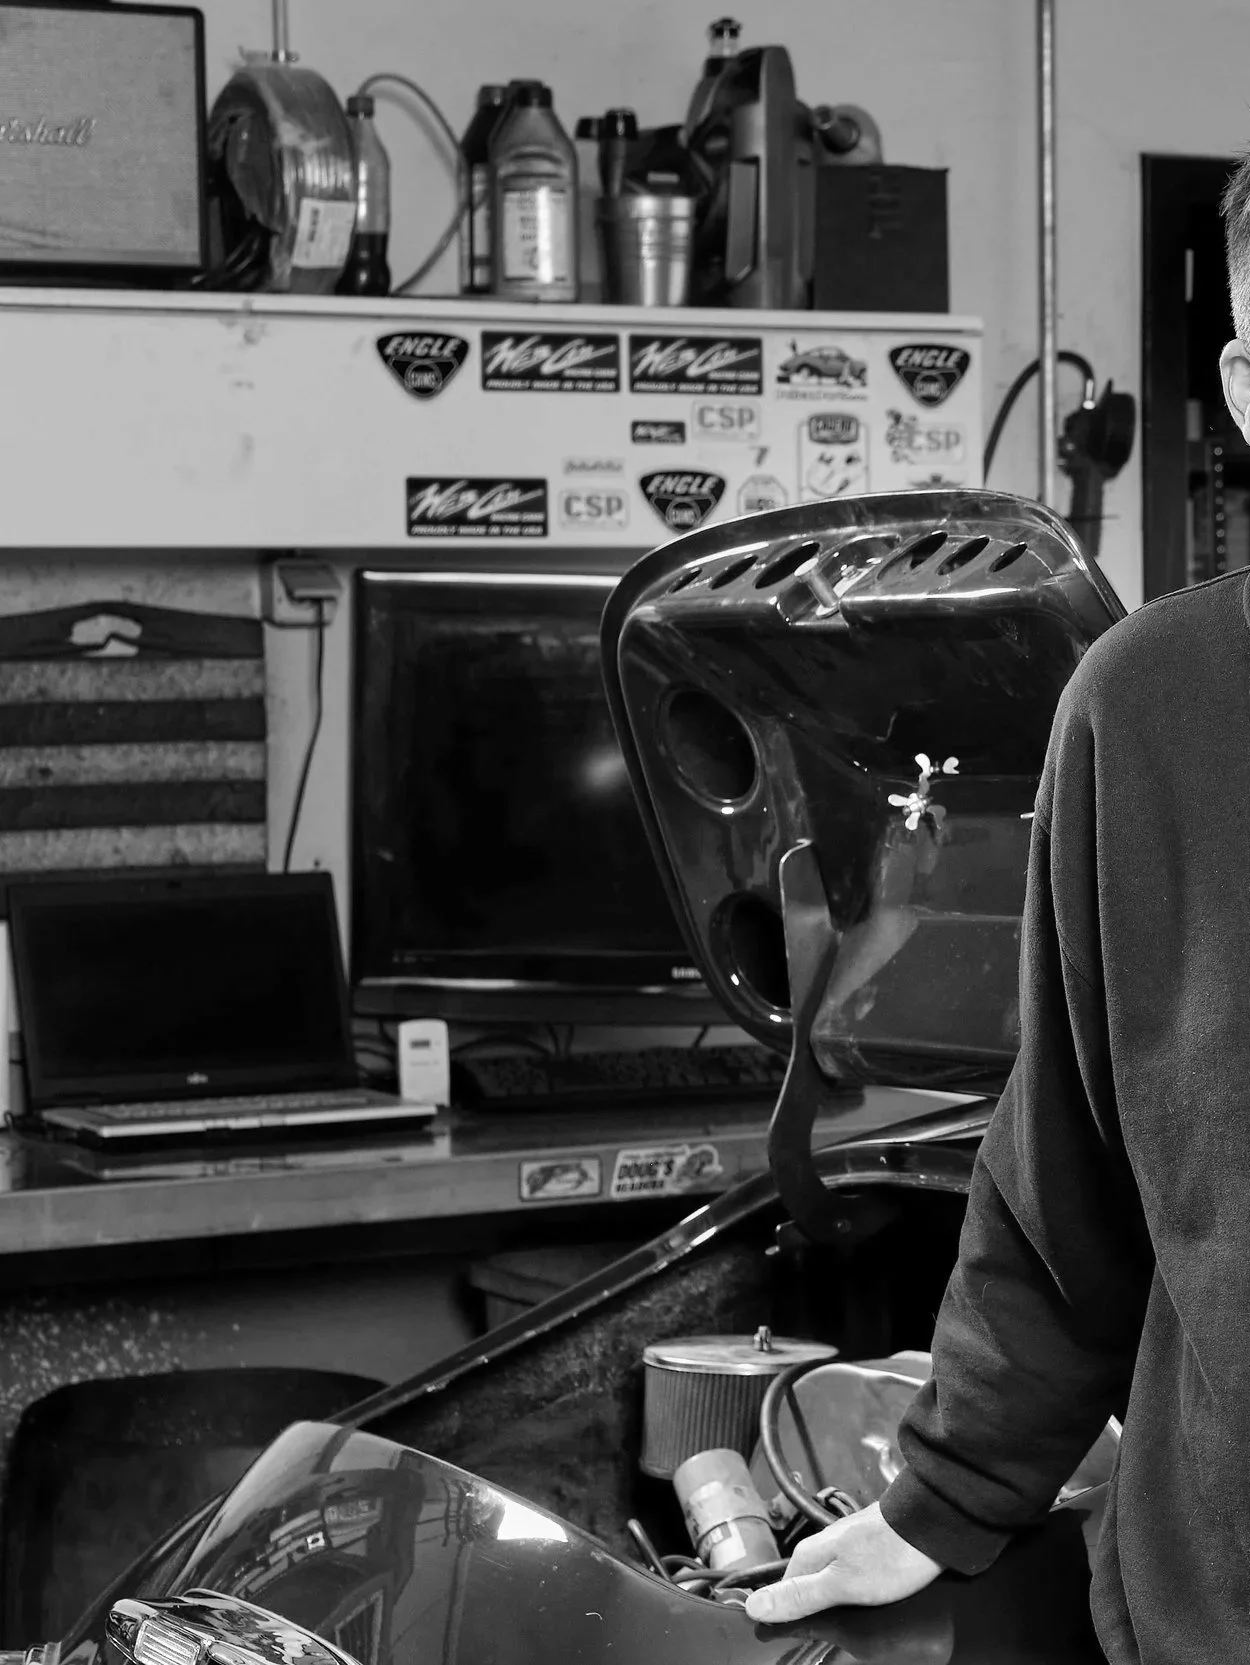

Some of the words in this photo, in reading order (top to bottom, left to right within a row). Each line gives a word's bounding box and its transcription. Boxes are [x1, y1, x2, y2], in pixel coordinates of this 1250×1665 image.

[384, 337, 462, 358] ENGLE
[895, 348, 966, 369] ENGLE
[698, 405, 755, 429] CSP
[646, 473, 720, 495] ENGLE
[563, 495, 623, 518] CSP
